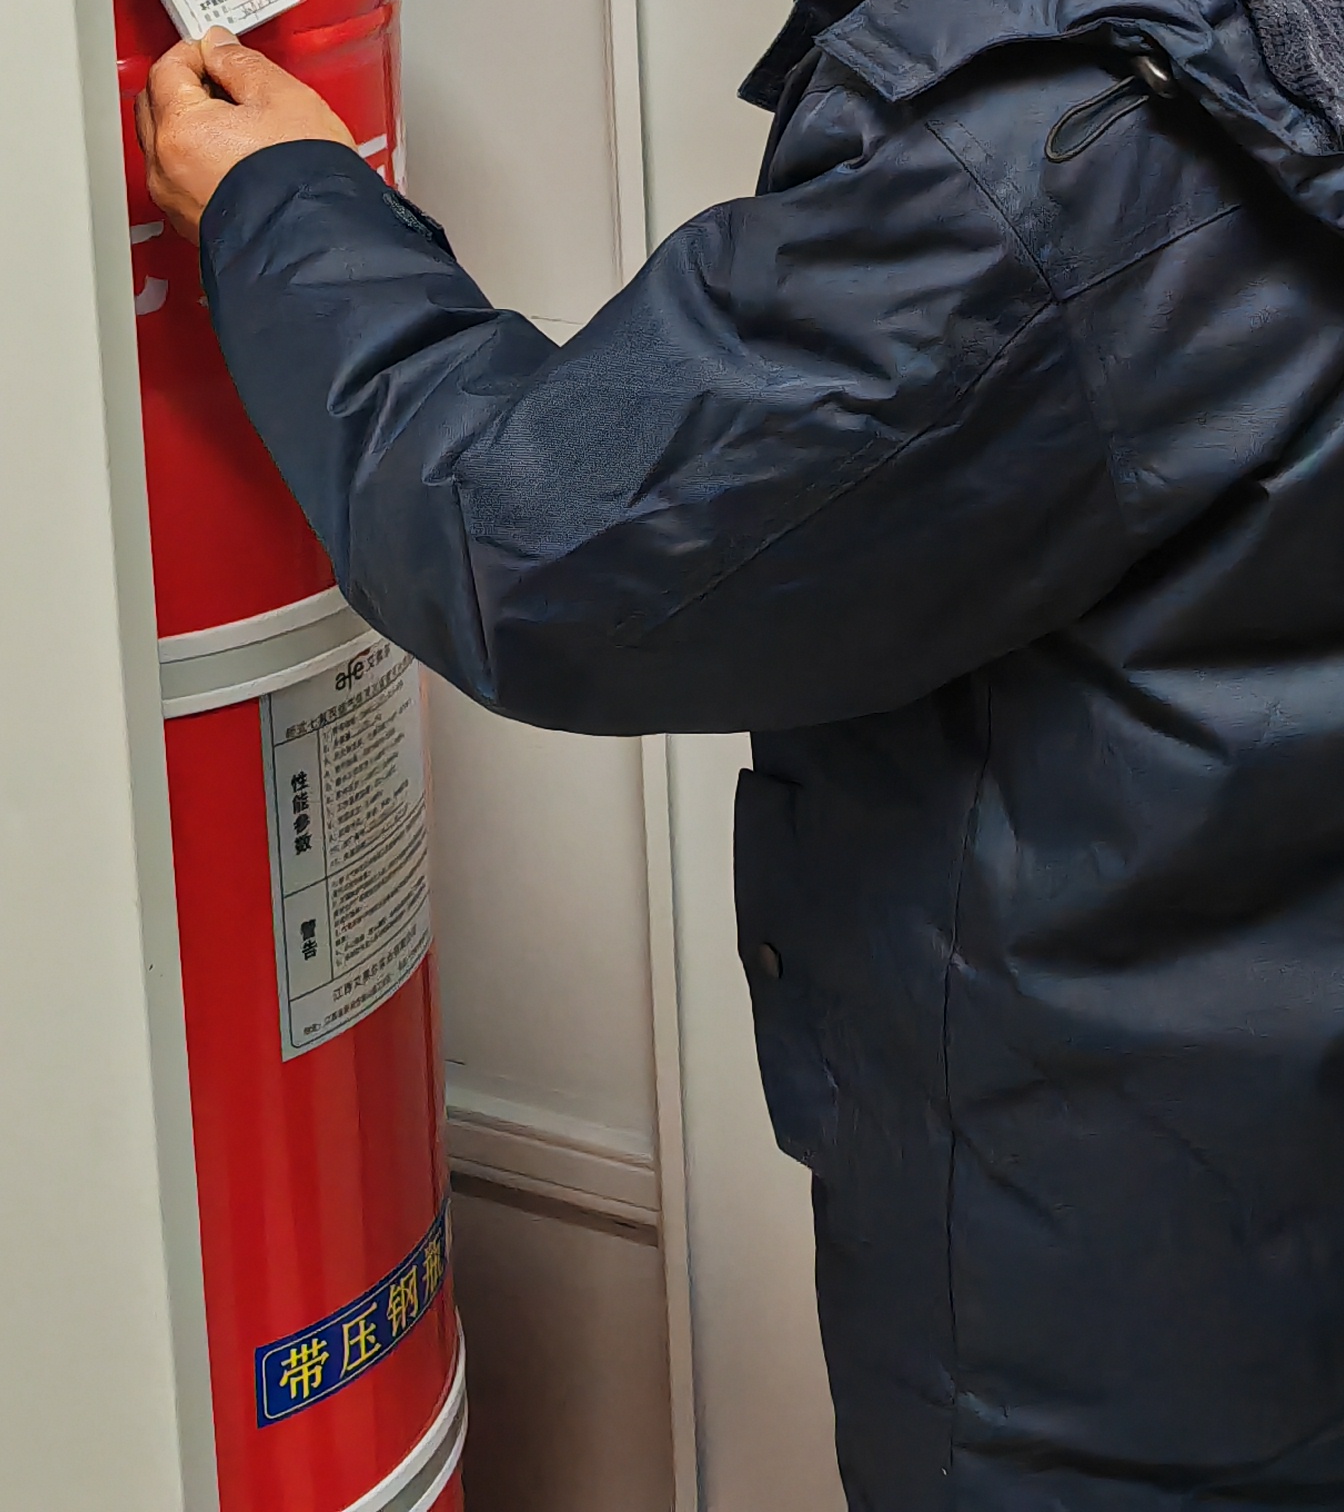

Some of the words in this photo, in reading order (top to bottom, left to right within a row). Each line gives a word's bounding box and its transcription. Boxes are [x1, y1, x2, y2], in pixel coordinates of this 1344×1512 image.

[291, 770, 313, 856] 性能参数
[279, 1229, 443, 1399] 带压钢瓶
